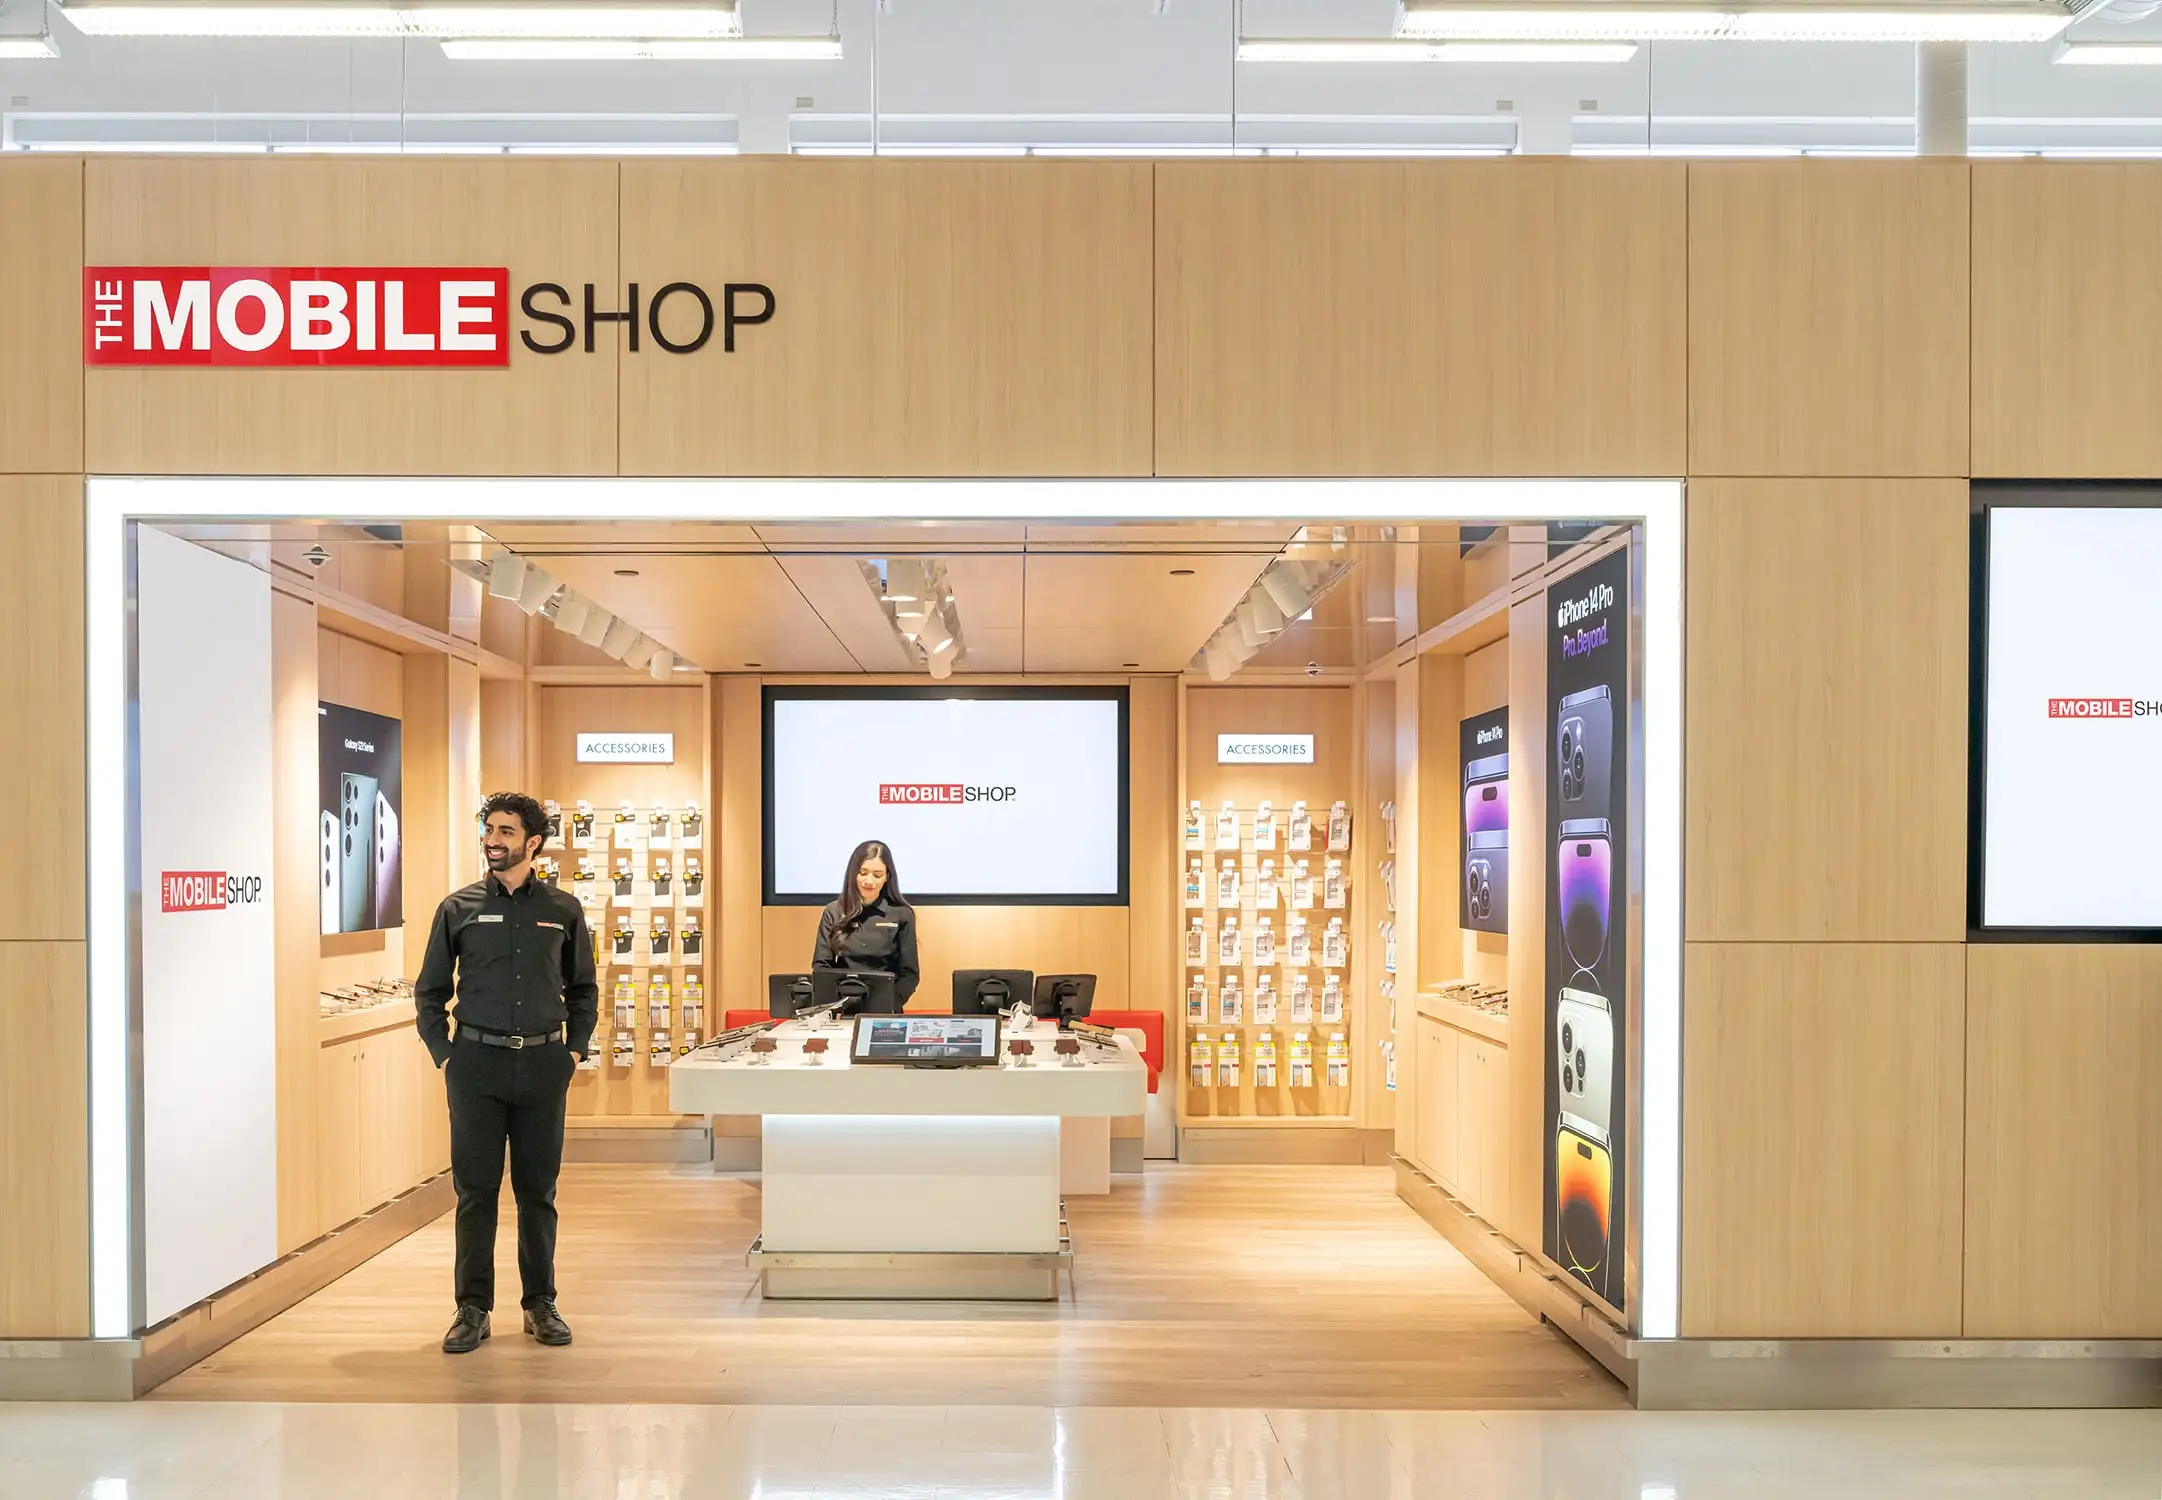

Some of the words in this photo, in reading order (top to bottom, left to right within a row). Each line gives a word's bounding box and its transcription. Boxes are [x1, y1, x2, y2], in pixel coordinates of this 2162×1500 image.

[95, 278, 123, 350] THE
[133, 278, 496, 352] MOBILE
[520, 281, 776, 354] SHOP
[1563, 599, 1589, 626] iPhone
[1589, 586, 1598, 614] 14
[1599, 584, 1613, 610] Pro
[1563, 634, 1577, 661] Pro.
[1577, 618, 1608, 659] Beyond.
[2059, 701, 2131, 716] MOBILE
[2134, 701, 2162, 716] SH
[585, 743, 665, 753] ACCESSORIES
[1226, 744, 1306, 755] ACCESSORIES
[890, 786, 961, 801] MOBILE
[965, 786, 1016, 802] SHOP
[170, 876, 225, 905] MOBILE
[227, 876, 262, 904] SHOP
